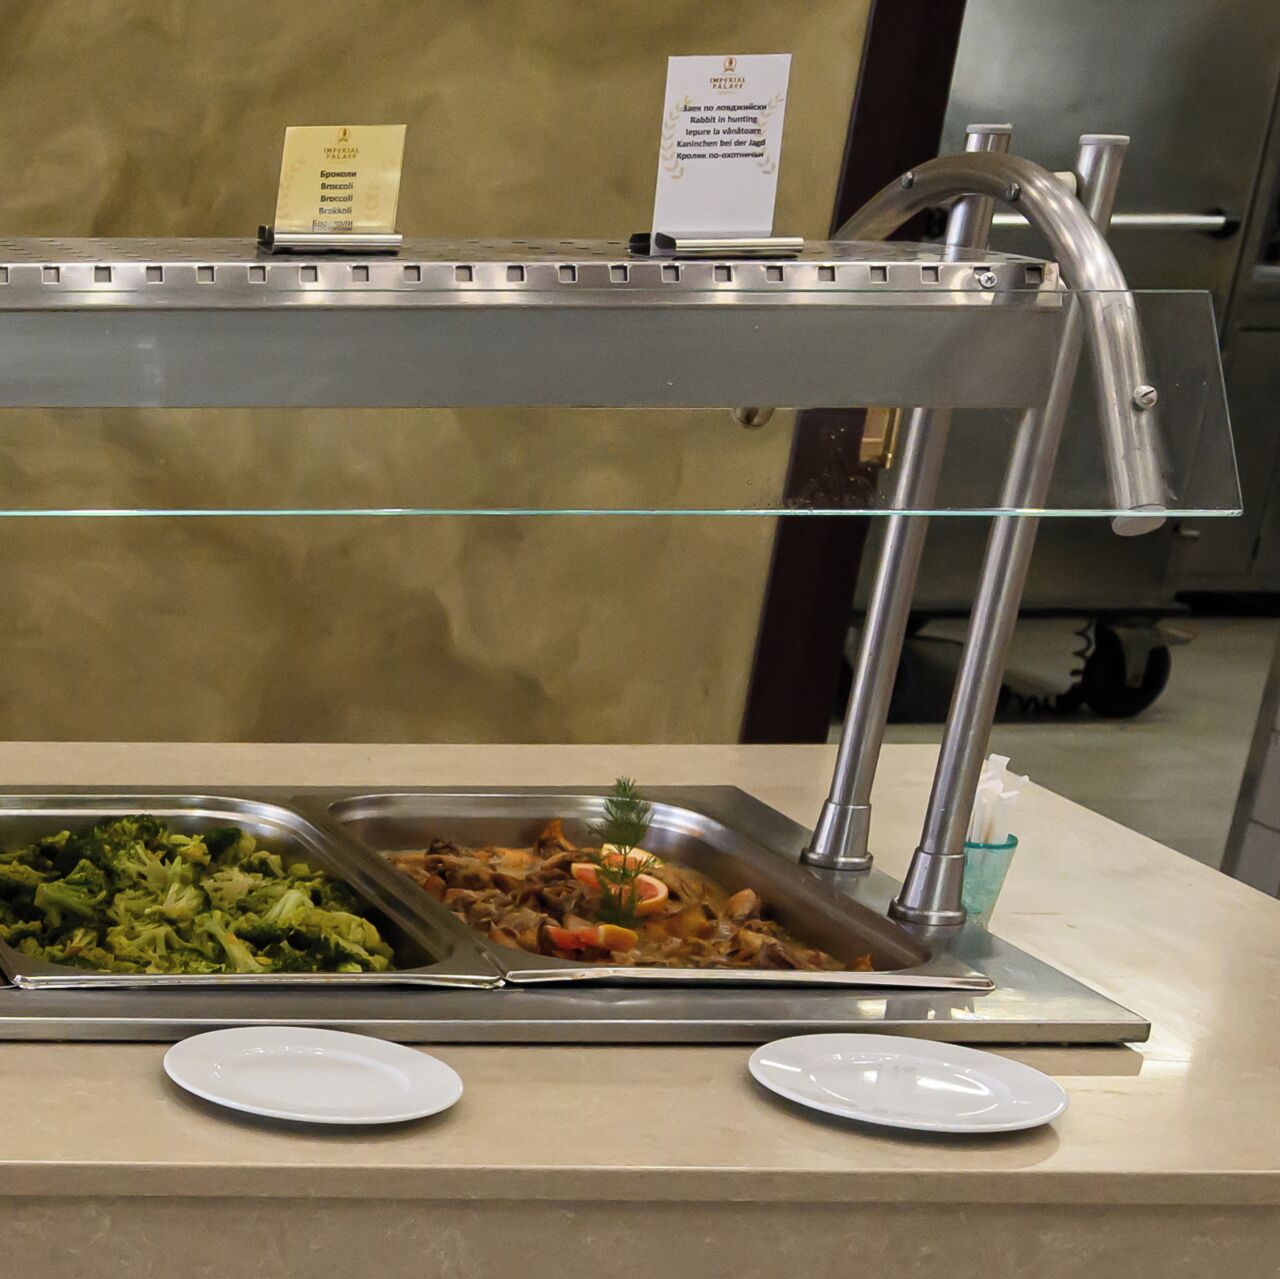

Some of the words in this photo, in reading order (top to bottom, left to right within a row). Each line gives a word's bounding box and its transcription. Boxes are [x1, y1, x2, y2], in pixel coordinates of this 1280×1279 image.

[683, 104, 701, 112] Заек
[728, 116, 757, 124] hunting
[686, 129, 710, 137] Iepure
[713, 127, 720, 135] la
[720, 139, 731, 147] bei
[749, 139, 766, 147] Jagd
[677, 152, 706, 160] Кролик
[320, 170, 357, 179] Броколи
